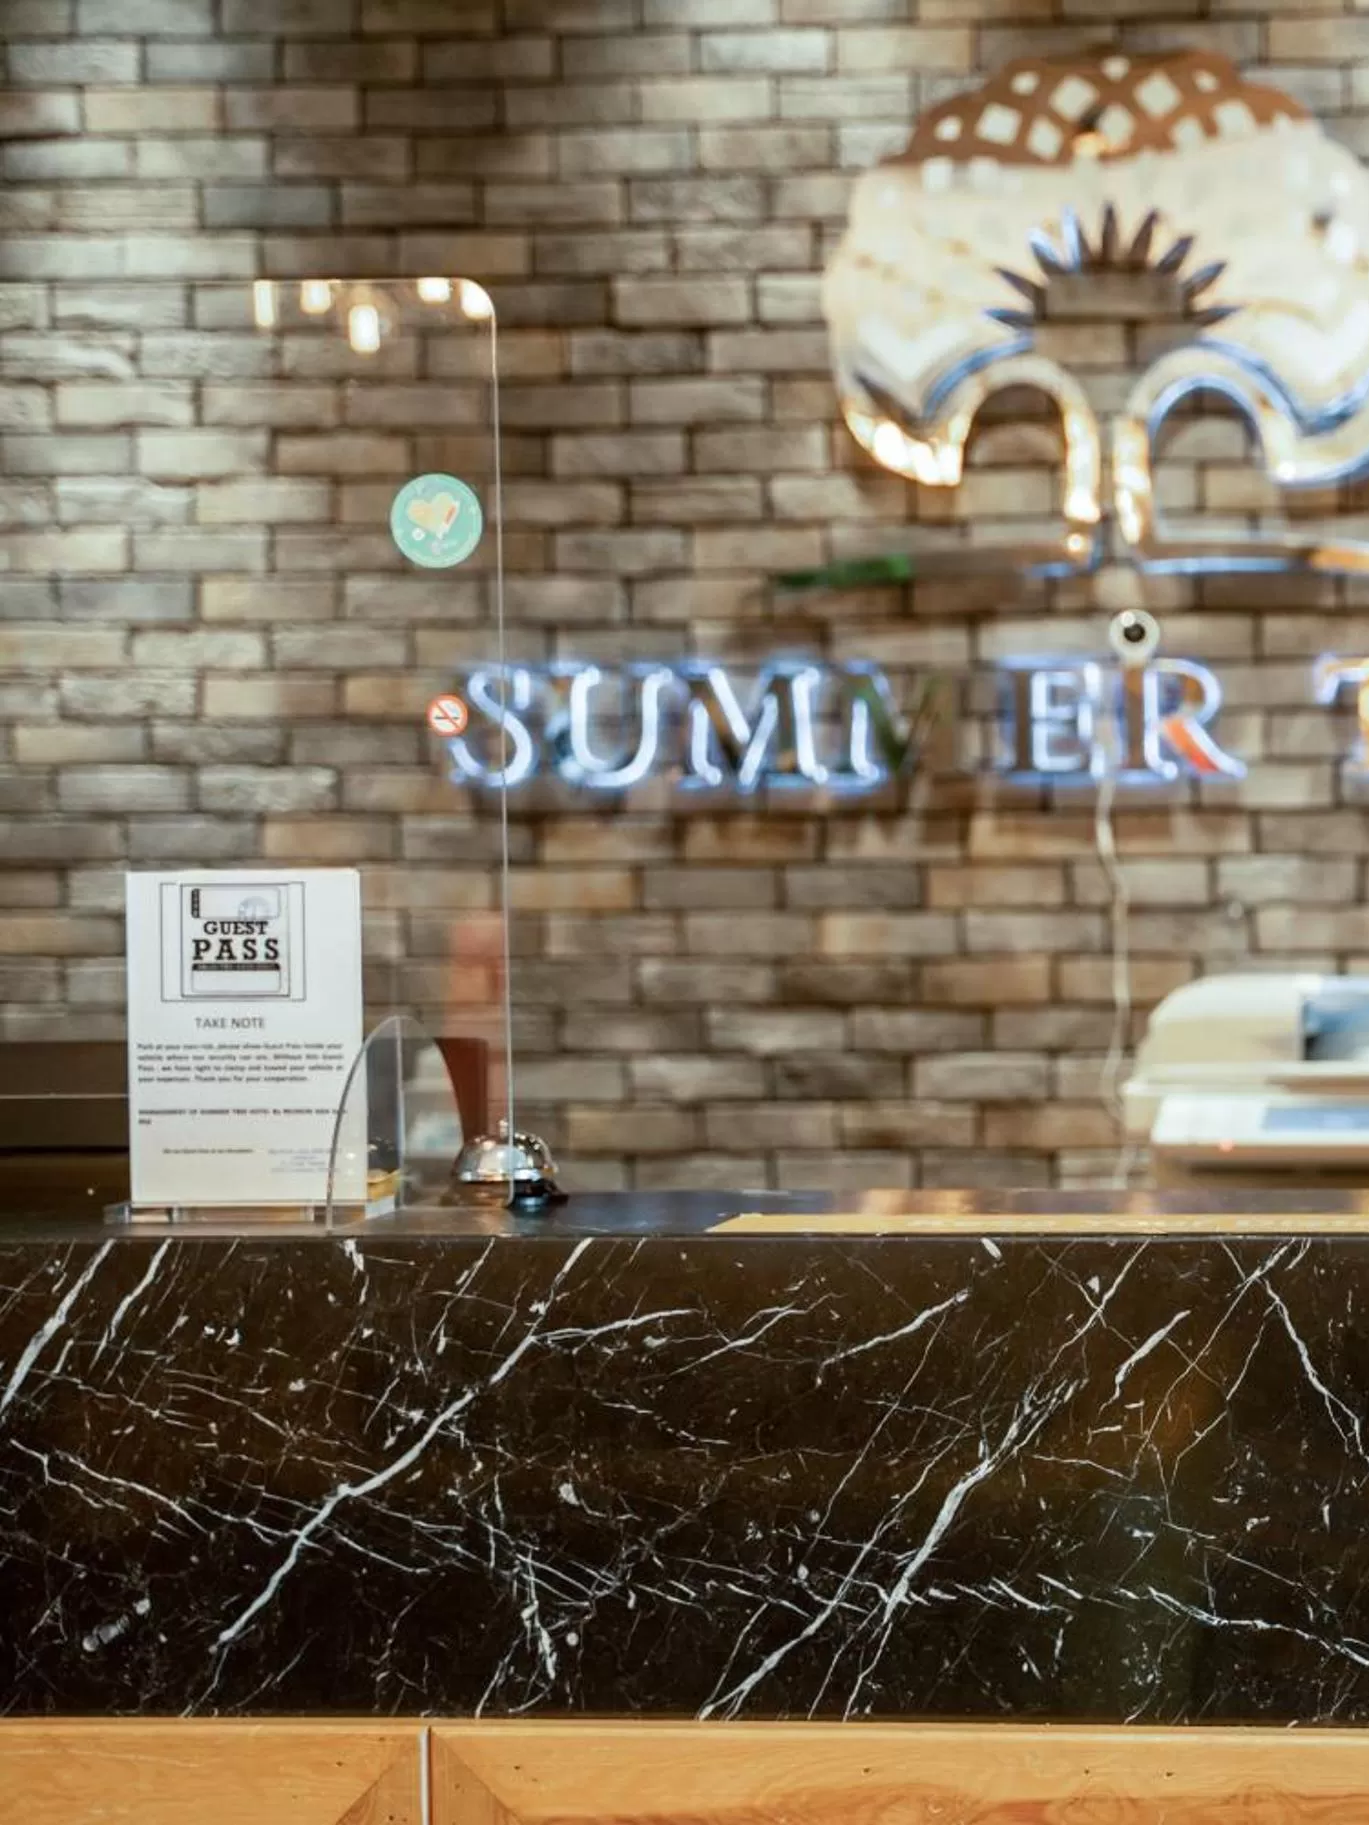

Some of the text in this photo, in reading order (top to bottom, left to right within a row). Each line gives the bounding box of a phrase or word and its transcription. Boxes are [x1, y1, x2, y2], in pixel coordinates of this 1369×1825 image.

[450, 657, 1246, 787] SUMMER
[203, 920, 268, 935] GUEST
[192, 938, 280, 961] PASS
[194, 1016, 265, 1029] TAKE NOTE
